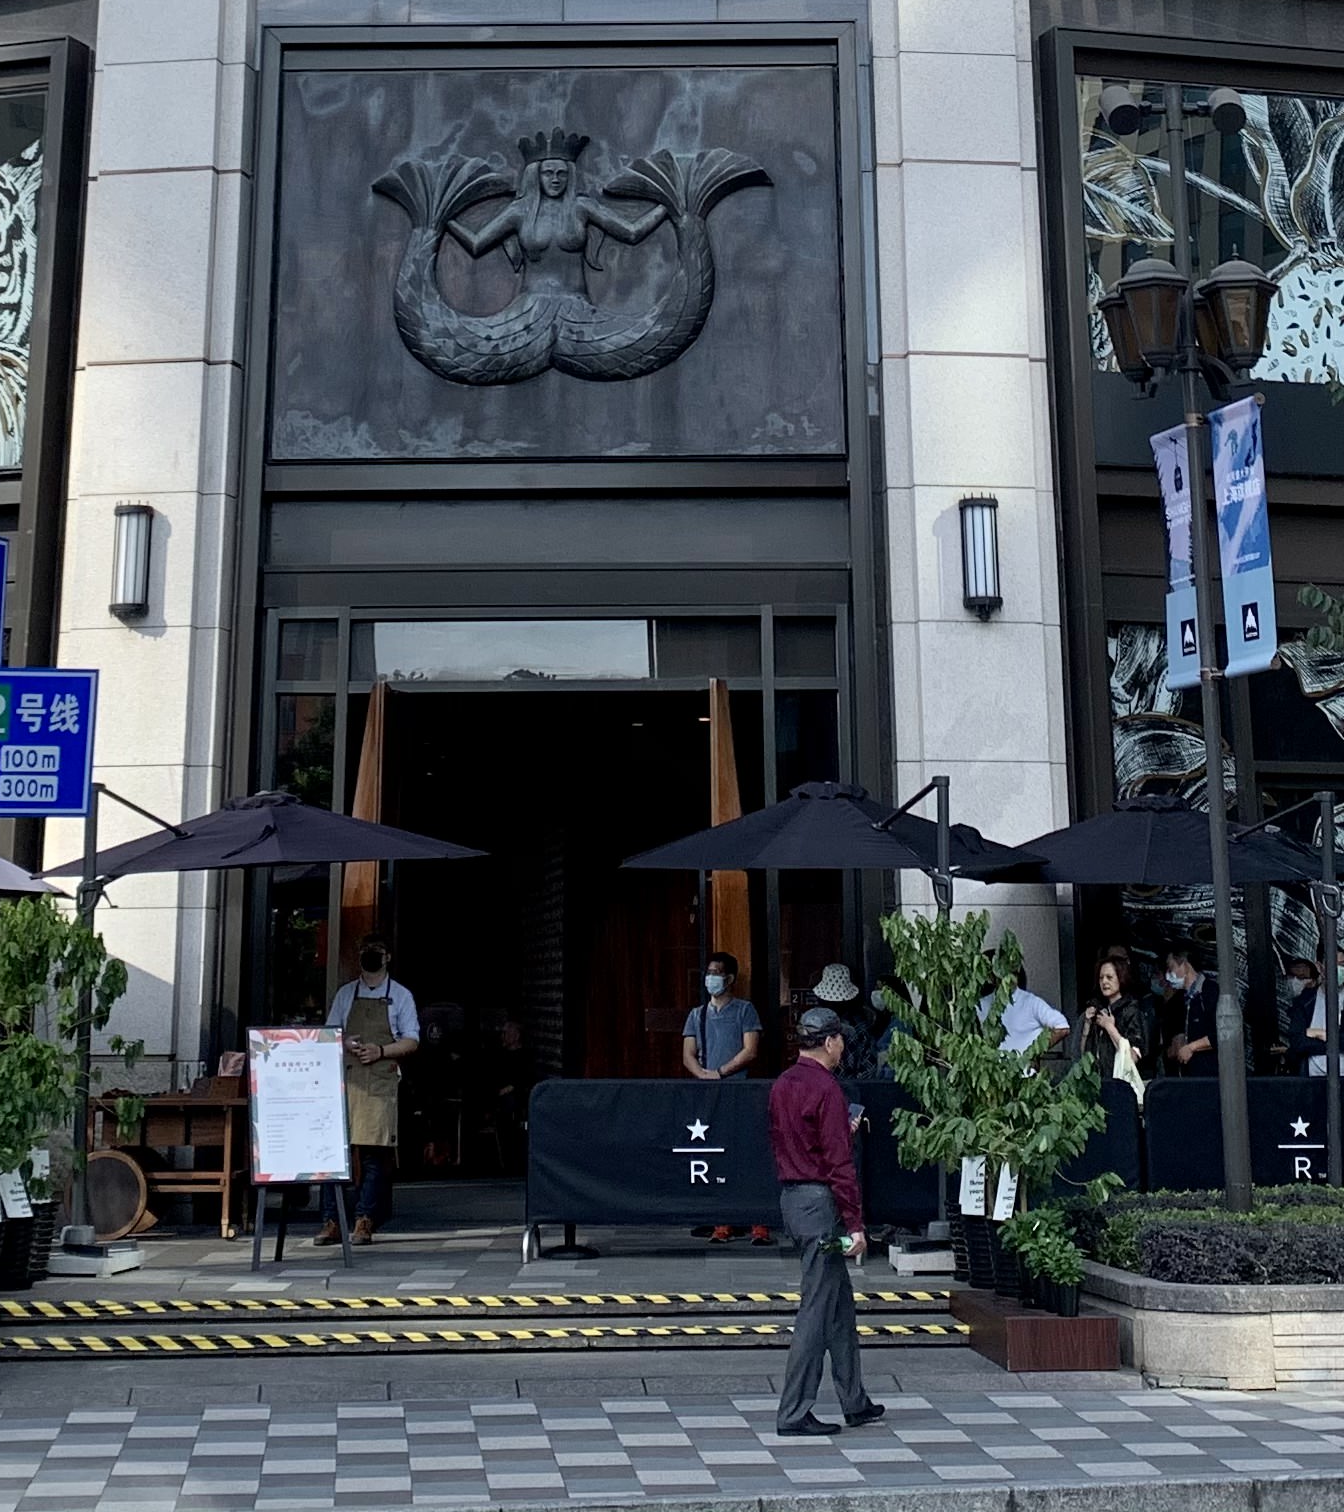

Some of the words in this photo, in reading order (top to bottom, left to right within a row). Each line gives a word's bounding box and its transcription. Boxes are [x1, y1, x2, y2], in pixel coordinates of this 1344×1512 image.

[16, 693, 80, 735] 号线
[5, 750, 57, 768] 100m
[1, 779, 55, 798] 300m
[690, 1160, 709, 1184] R
[1295, 1156, 1312, 1179] R
